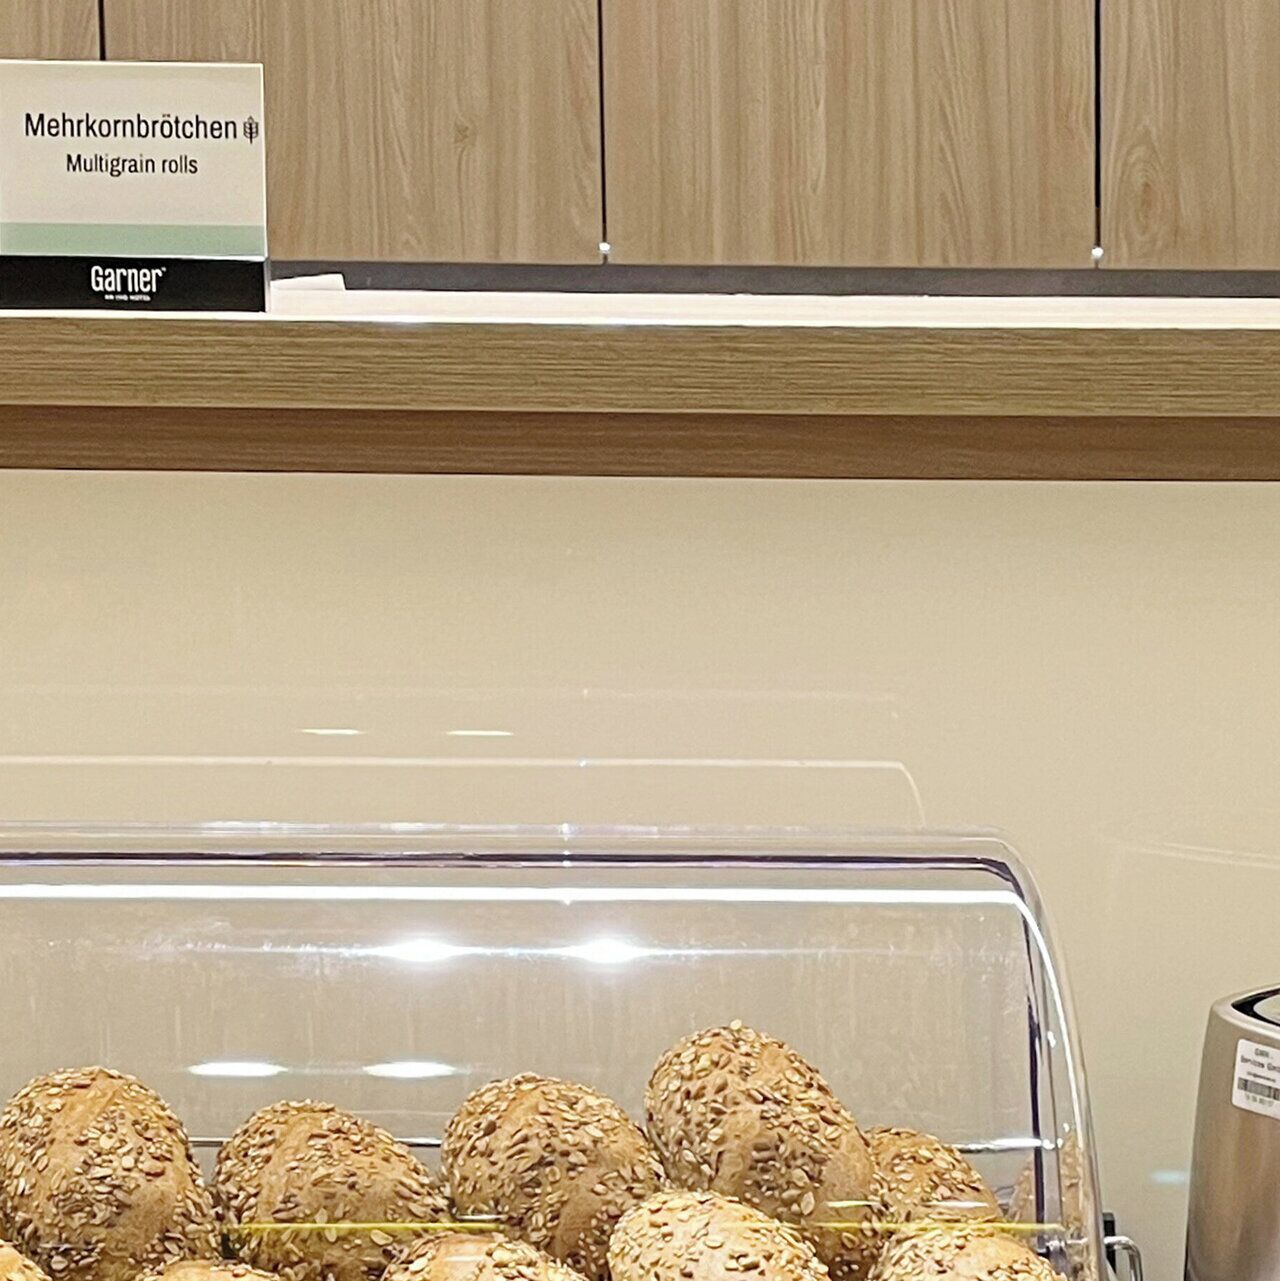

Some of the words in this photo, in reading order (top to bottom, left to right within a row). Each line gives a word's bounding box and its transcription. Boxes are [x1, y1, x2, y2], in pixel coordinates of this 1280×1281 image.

[24, 112, 238, 140] Mehrkornbrötchen
[66, 153, 156, 178] Multigrain
[161, 155, 199, 174] rolls
[91, 265, 163, 293] Garner
